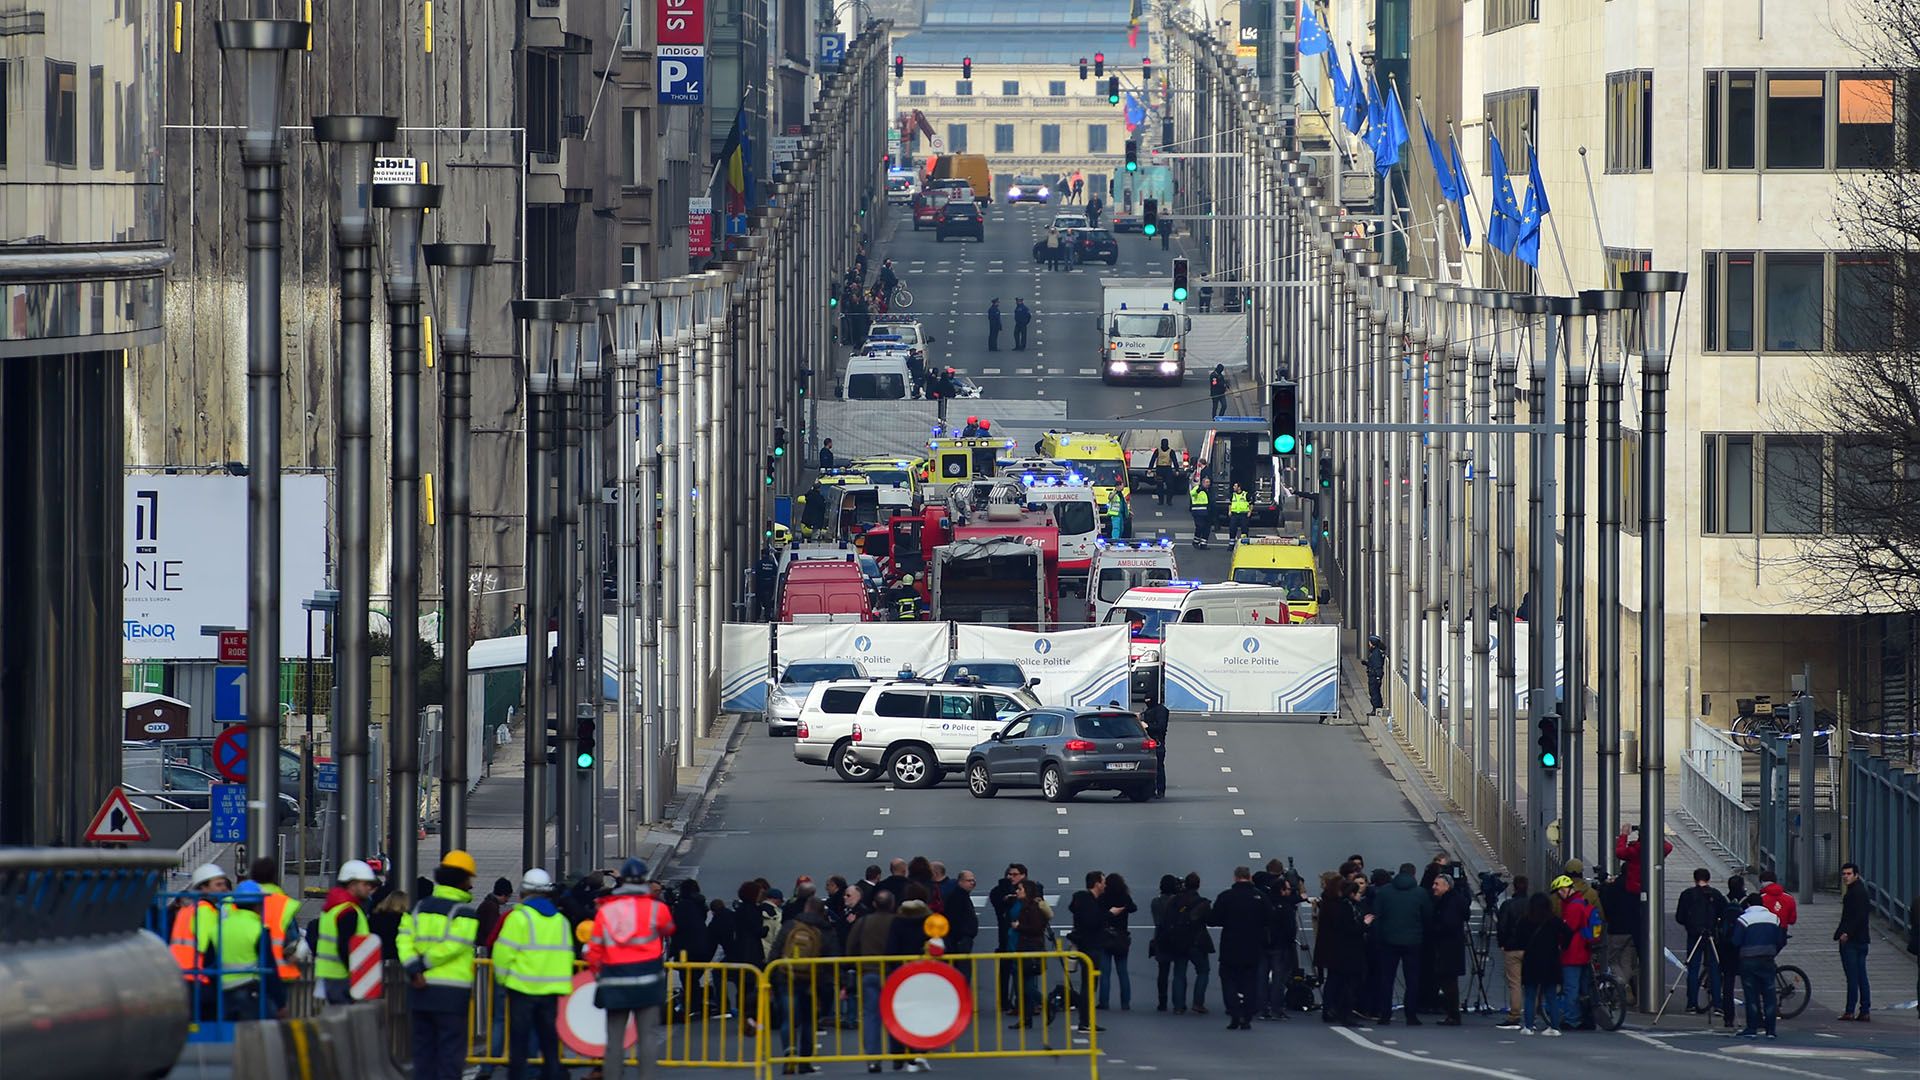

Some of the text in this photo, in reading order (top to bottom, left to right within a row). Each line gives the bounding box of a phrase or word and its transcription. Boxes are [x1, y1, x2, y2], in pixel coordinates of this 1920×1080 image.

[822, 37, 839, 56] P
[662, 48, 699, 56] INDIGO
[661, 60, 688, 93] P
[1023, 536, 1046, 548] Car
[228, 648, 247, 656] RODE
[864, 655, 891, 664] Politie
[1015, 657, 1071, 666] Police Politie
[1223, 657, 1280, 666] Police Politie
[952, 723, 975, 731] Police
[230, 817, 238, 826] 7
[227, 829, 240, 839] 16
